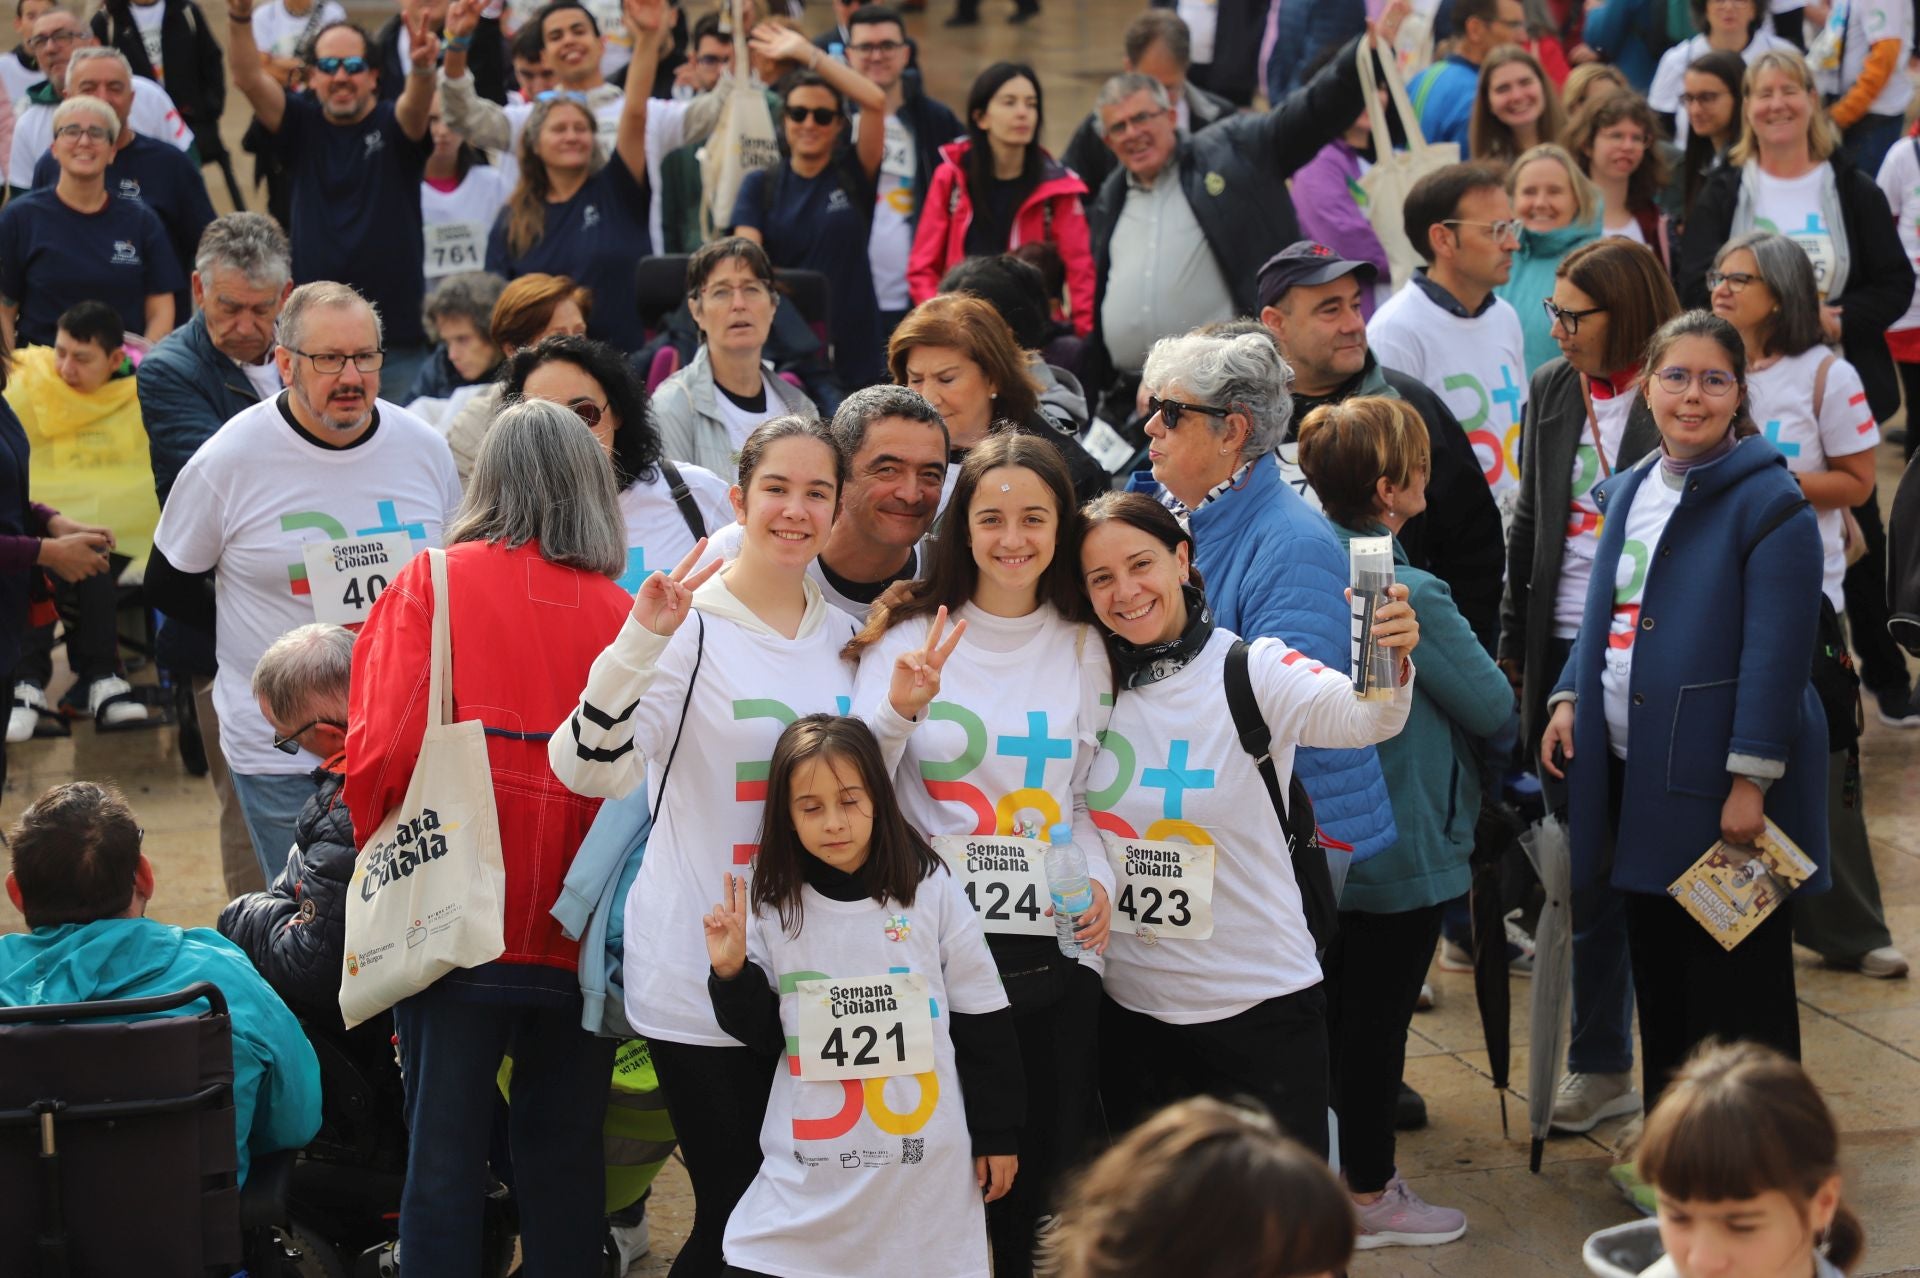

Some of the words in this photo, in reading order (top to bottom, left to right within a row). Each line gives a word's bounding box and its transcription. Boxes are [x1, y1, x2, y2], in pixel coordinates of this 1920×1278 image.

[433, 244, 478, 267] 761
[333, 542, 384, 558] Semana
[335, 552, 389, 572] Cidiana
[966, 842, 1026, 858] Semana
[1126, 845, 1180, 863] Semana
[966, 856, 1030, 873] Cidiana
[1126, 859, 1183, 878] Cidiana
[1118, 884, 1192, 927] 423
[359, 942, 395, 960] Ayuntamiento
[366, 954, 383, 966] Burgos
[830, 984, 893, 1001] Semana
[831, 999, 898, 1019] Cidiana
[820, 1022, 906, 1066] 421
